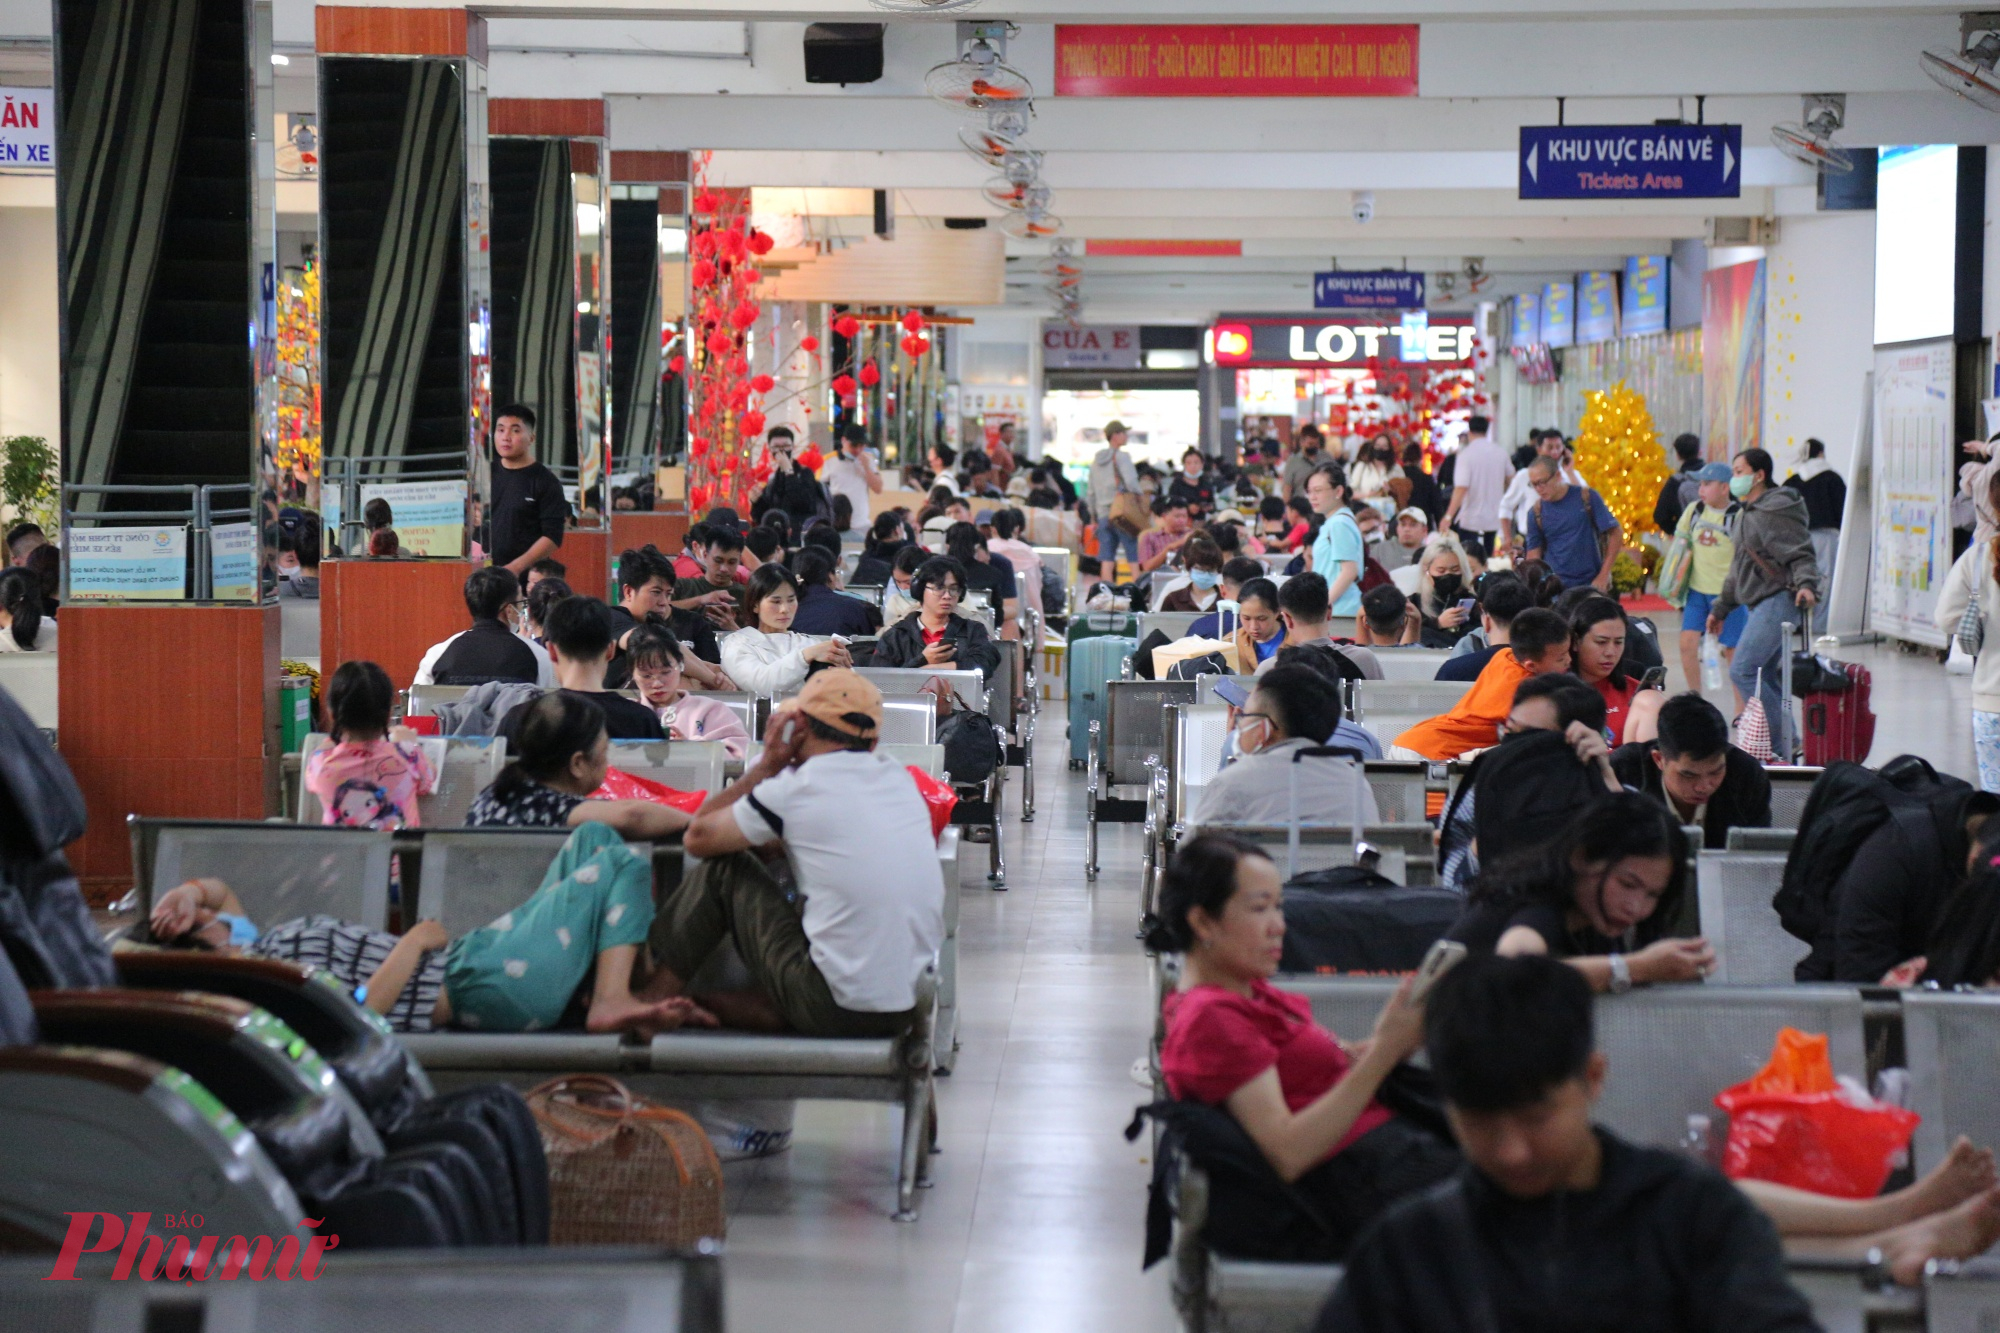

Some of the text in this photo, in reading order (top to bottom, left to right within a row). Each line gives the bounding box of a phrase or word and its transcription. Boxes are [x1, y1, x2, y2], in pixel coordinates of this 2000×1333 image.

[1258, 36, 1292, 77] TRÁCH
[1332, 31, 1352, 77] CỦA
[1356, 44, 1376, 84] MỌI
[26, 144, 50, 161] XE
[1548, 135, 1713, 167] KHU VỰC BÁN VÉ
[1578, 171, 1683, 190] Tickets Area
[1327, 277, 1350, 290] KHU
[1352, 277, 1373, 292] VỰC
[1374, 275, 1397, 291] BÁN
[1112, 330, 1131, 349] E
